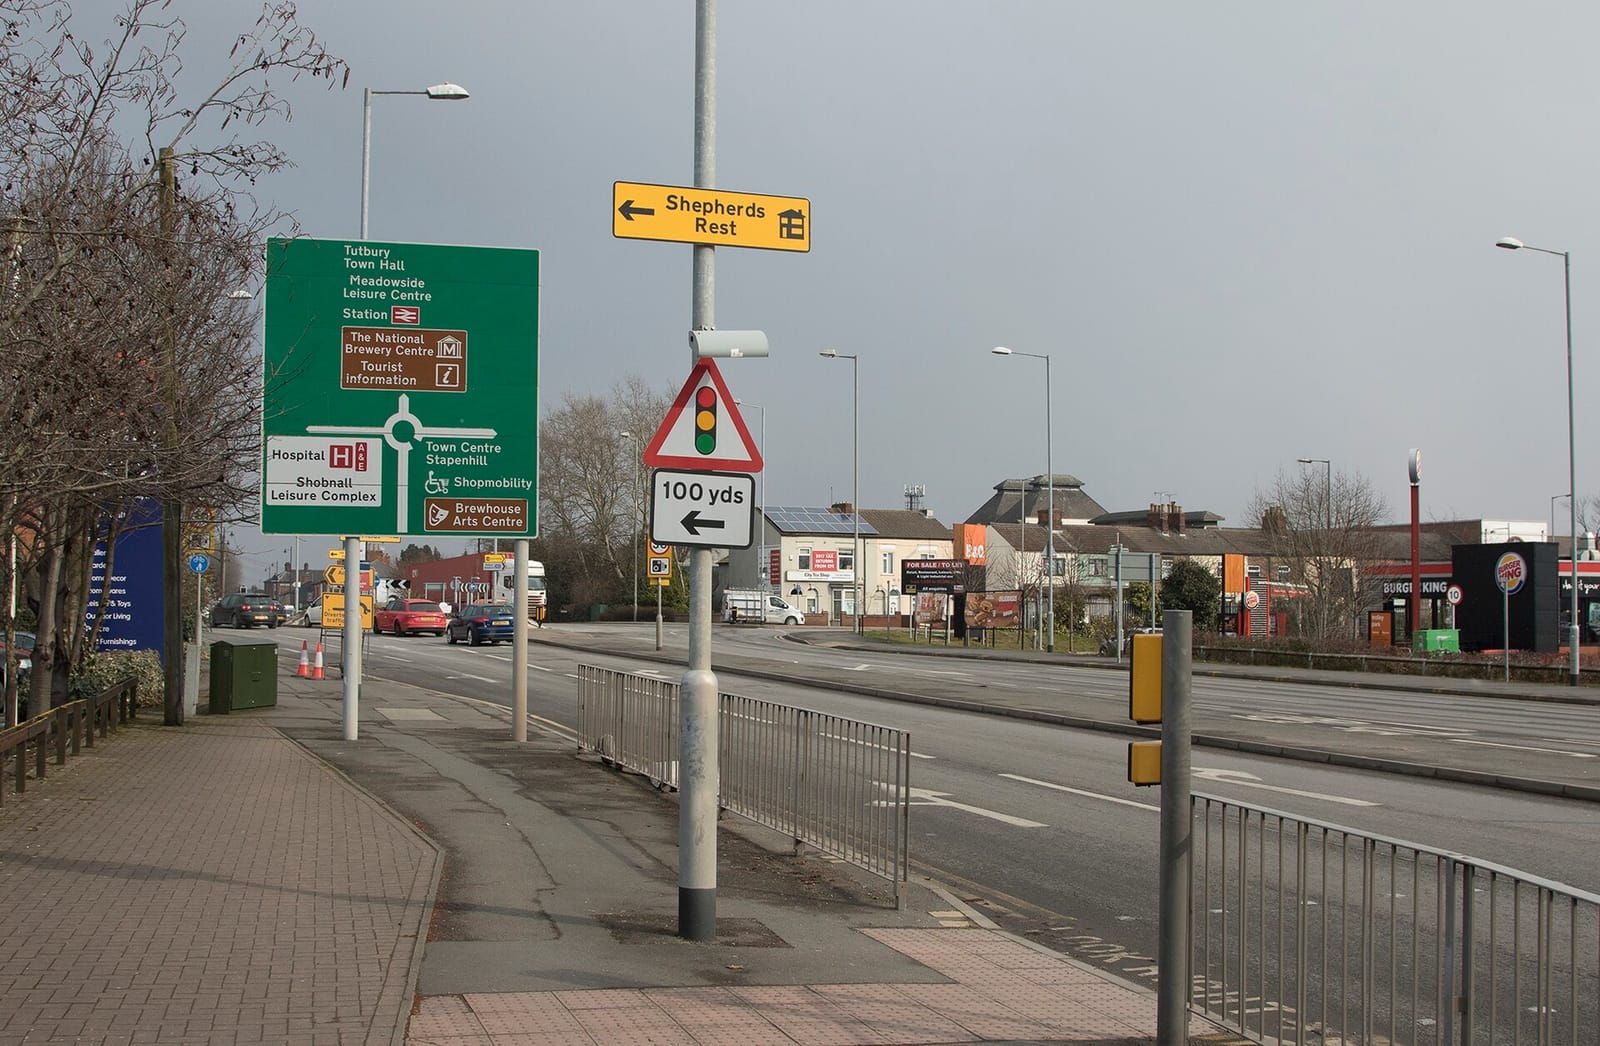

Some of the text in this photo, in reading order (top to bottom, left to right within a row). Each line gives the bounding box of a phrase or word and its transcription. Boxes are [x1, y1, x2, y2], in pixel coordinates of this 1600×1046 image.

[666, 194, 766, 218] Shepherds
[695, 217, 737, 236] Rest
[344, 245, 391, 259] Tutbury
[344, 258, 405, 271] Town Hall
[350, 276, 425, 289] Meadowside
[343, 288, 432, 302] Leisure Centre
[343, 308, 388, 320] Station
[350, 332, 424, 345] The National
[345, 344, 434, 357] Brewery Centre
[360, 361, 403, 373] Tourist
[345, 374, 417, 386] information
[426, 441, 502, 454] Town Centre
[272, 449, 326, 465] Hospital
[333, 447, 350, 467] H
[426, 454, 488, 467] Stapenhill
[296, 477, 353, 488] Shobnall
[454, 477, 533, 491] Shopmobility
[271, 491, 377, 504] Leisure Complex
[663, 481, 744, 506] 100 yds
[455, 503, 521, 515] Brewhouse
[453, 516, 524, 528] Arts Centre
[966, 544, 985, 559] B&Q
[1498, 560, 1521, 575] BURGER
[1383, 581, 1448, 594] BURG KING
[1450, 589, 1460, 599] 10
[117, 600, 132, 608] Toys
[112, 612, 132, 621] Living
[100, 638, 137, 646] Furnishings
